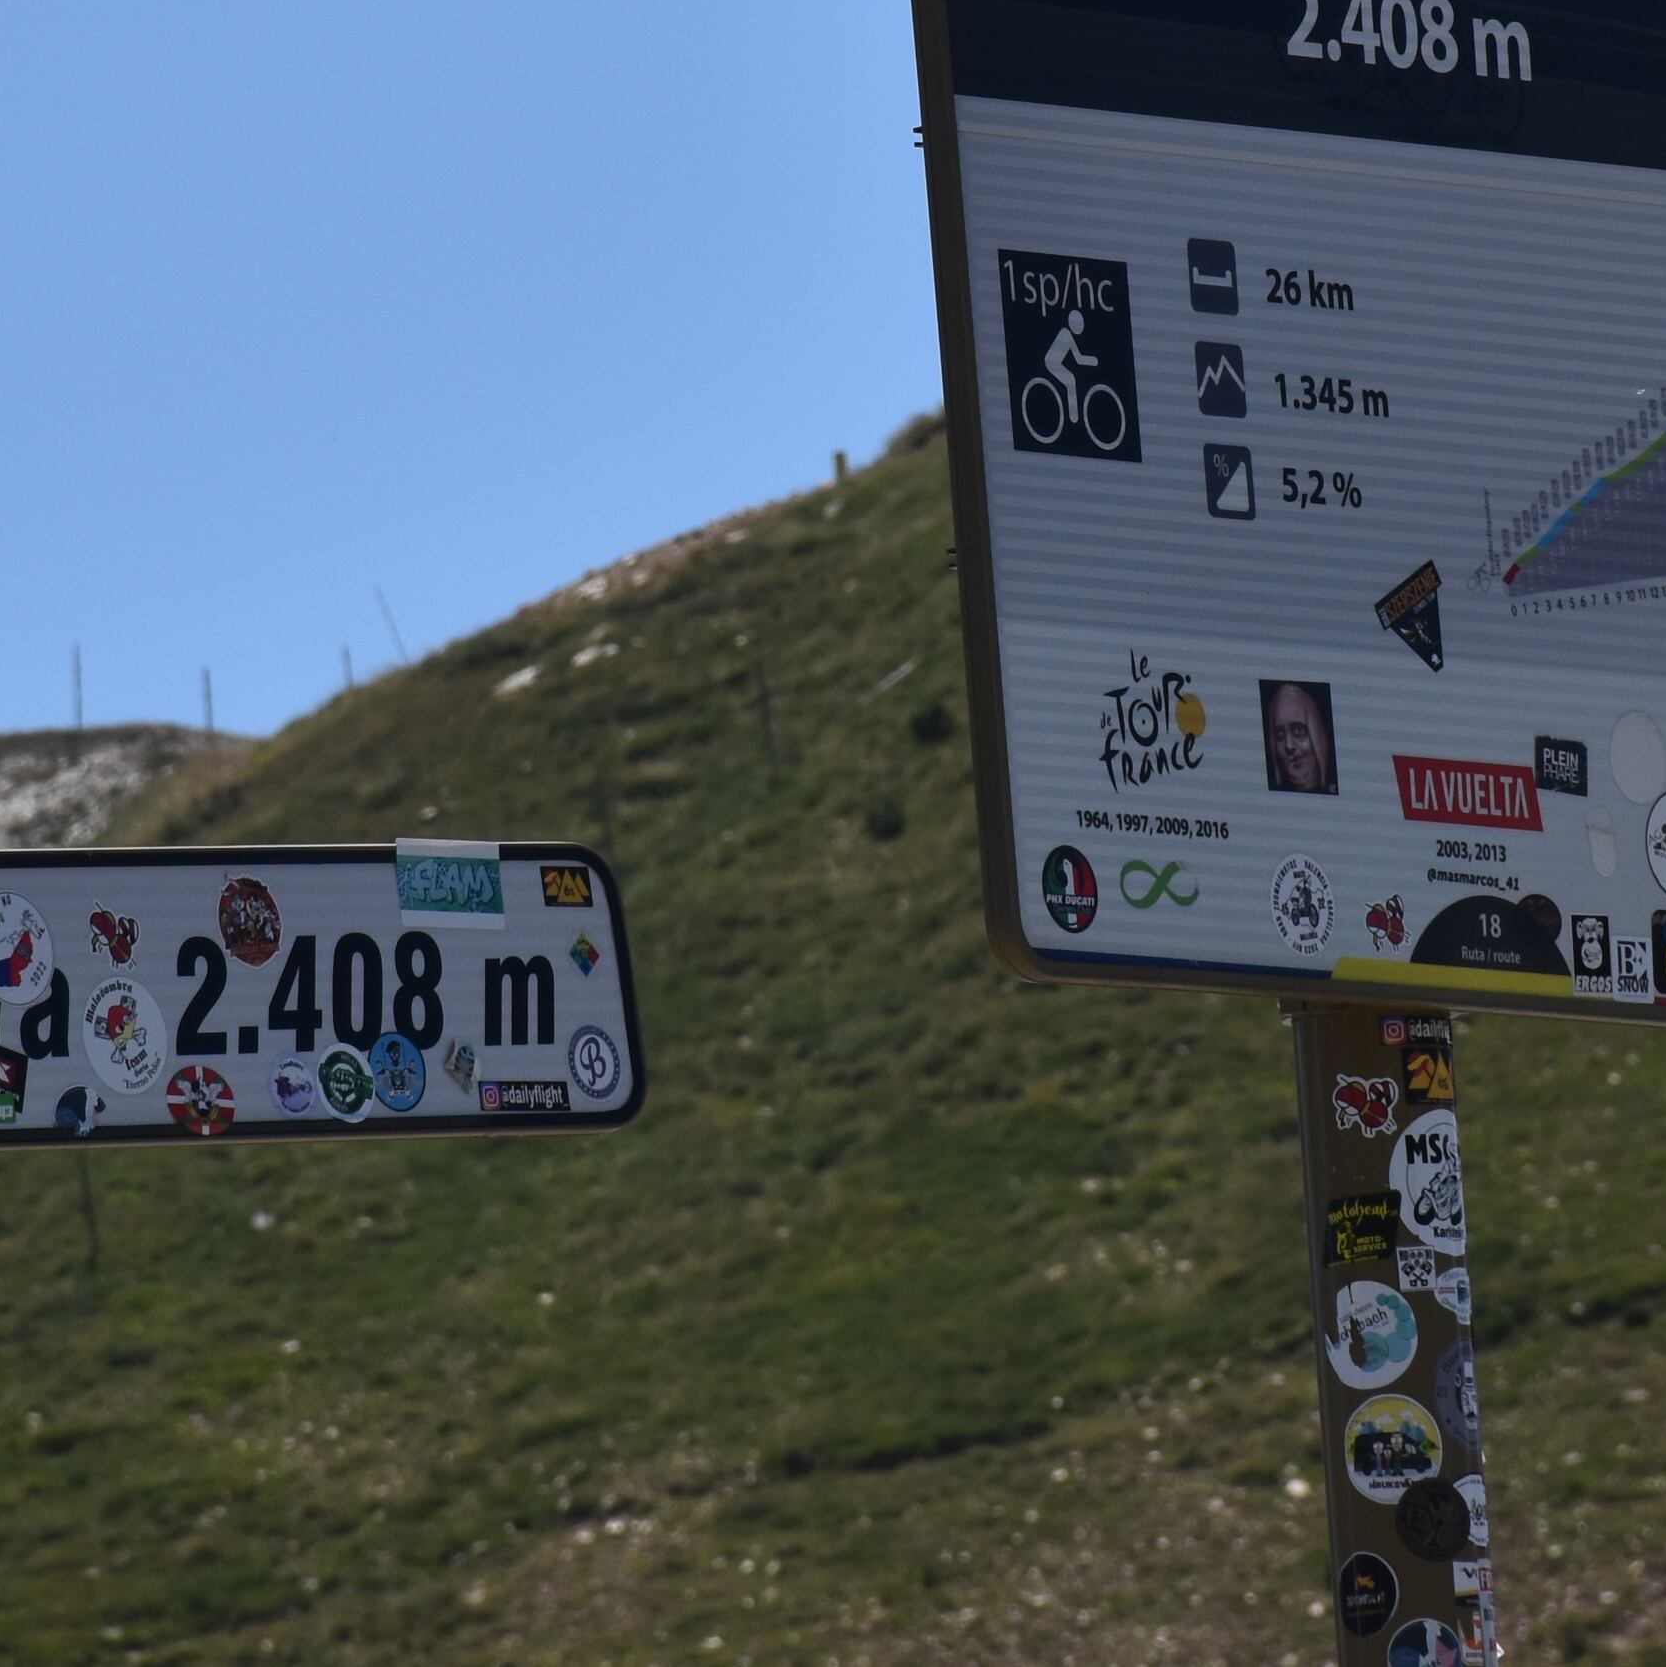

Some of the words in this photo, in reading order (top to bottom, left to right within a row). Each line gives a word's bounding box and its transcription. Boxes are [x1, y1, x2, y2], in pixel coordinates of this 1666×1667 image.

[1473, 14, 1533, 82] m
[1265, 268, 1302, 306] 26
[1308, 269, 1354, 311] km
[1274, 373, 1353, 414] 1.345
[1362, 385, 1390, 418] m
[1282, 467, 1326, 510] 5,2
[1333, 471, 1362, 508] %
[1511, 605, 1517, 617] 0
[1523, 603, 1527, 615] 1
[1533, 602, 1540, 614] 2
[1547, 600, 1552, 612] 3
[1557, 599, 1563, 610] 4
[1570, 597, 1575, 609] 5
[1581, 596, 1586, 608] 6
[1591, 594, 1596, 606] 7
[1604, 593, 1609, 604] 8
[1616, 592, 1622, 603] 9
[1626, 590, 1635, 602] 10
[1638, 589, 1647, 600] 11
[1650, 587, 1659, 599] 12
[1543, 747, 1579, 771] PLEIN
[1543, 762, 1580, 784] PHARE
[1408, 768, 1437, 811] LA
[1440, 770, 1530, 819] VUELTA
[1076, 809, 1113, 833] 1964,
[1116, 813, 1153, 835] 1997,
[1155, 816, 1192, 839] 2009,
[1195, 820, 1229, 840] 2016
[1436, 840, 1473, 862] 2003,
[1474, 842, 1507, 863] 2013
[1427, 868, 1519, 891] @masmarcos_41
[1046, 894, 1063, 904] PHX
[1065, 895, 1095, 907] DUCATI
[1478, 913, 1502, 938] 18
[1461, 945, 1485, 961] Ruta
[1487, 947, 1491, 961] /
[1493, 950, 1521, 965] route
[176, 931, 444, 1055] 2.408
[485, 954, 555, 1047] m
[1576, 975, 1612, 992] ERGOS
[1617, 977, 1649, 993] SNOW
